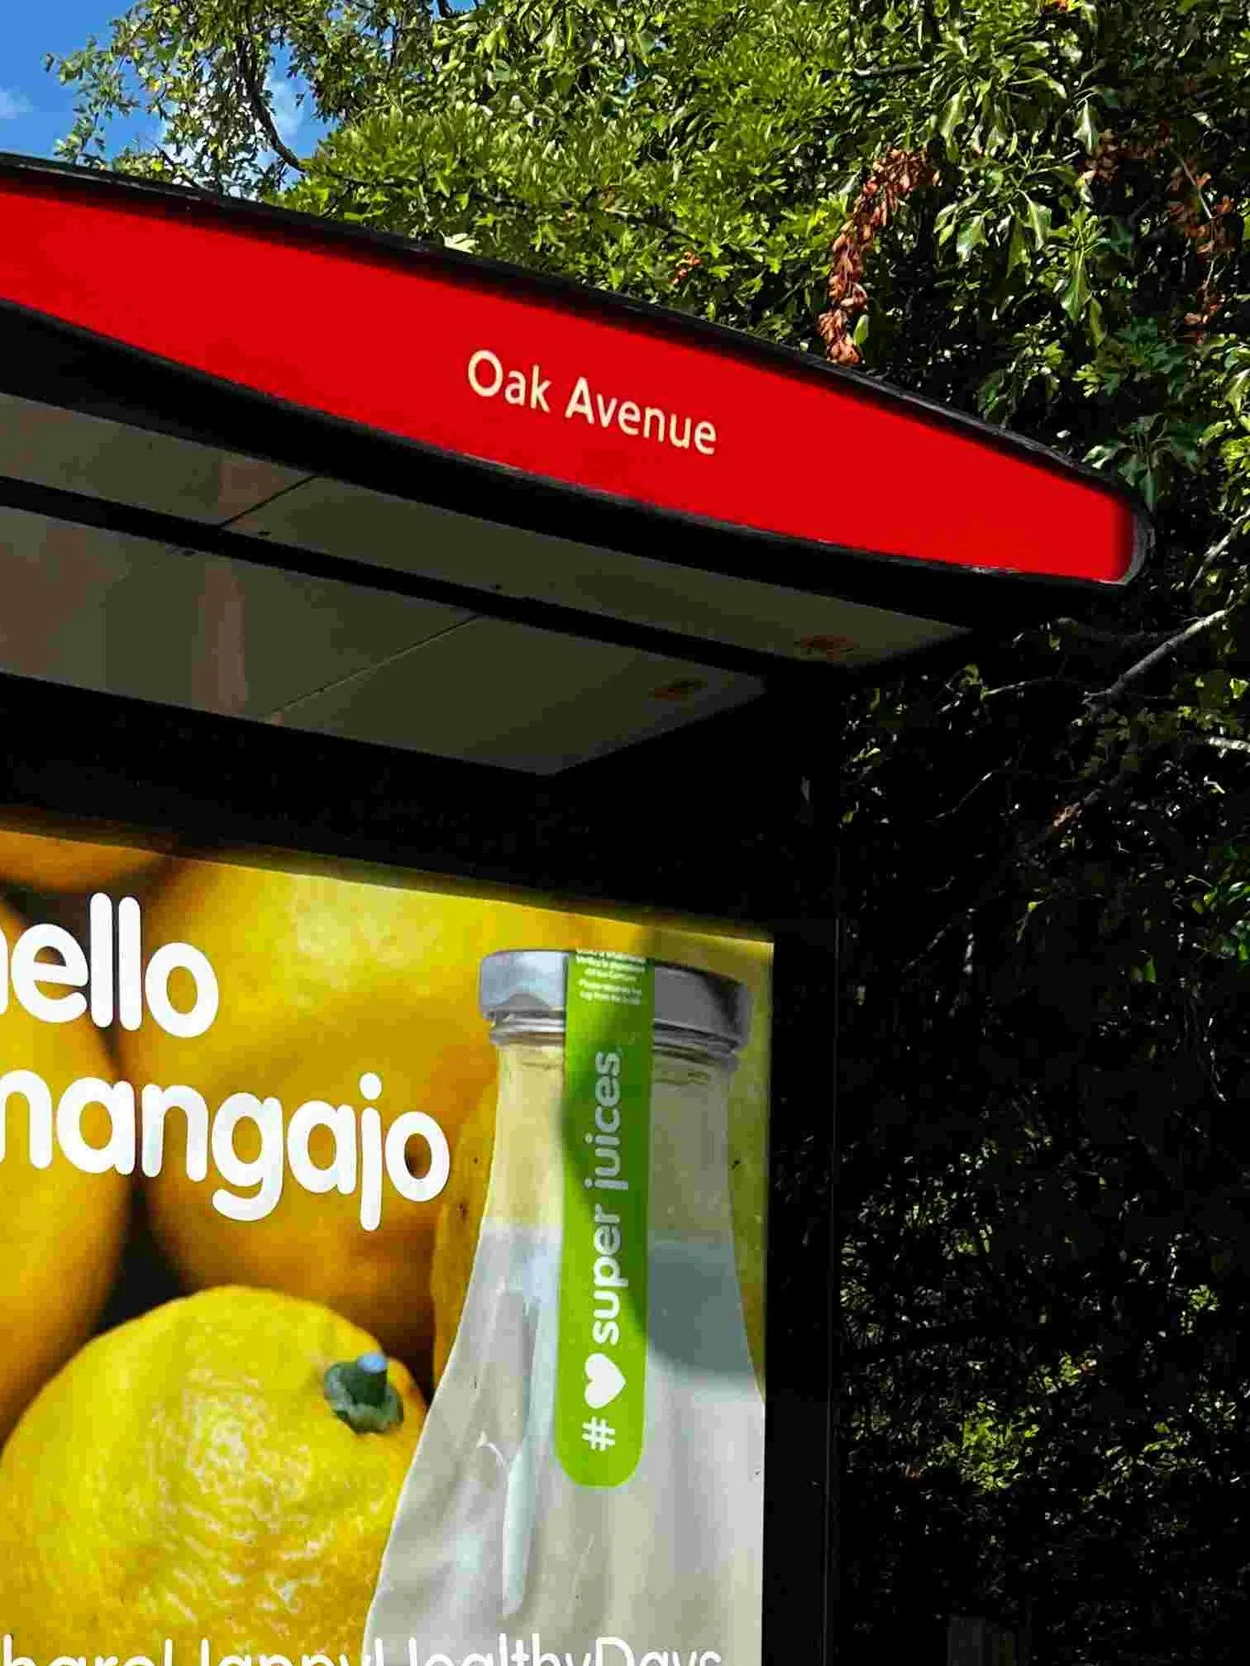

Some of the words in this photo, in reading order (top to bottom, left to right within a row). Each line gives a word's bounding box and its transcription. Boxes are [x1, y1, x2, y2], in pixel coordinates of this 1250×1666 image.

[467, 350, 552, 413] Oak
[565, 377, 718, 455] Avenue
[583, 1050, 629, 1192] juices
[591, 1203, 629, 1346] super
